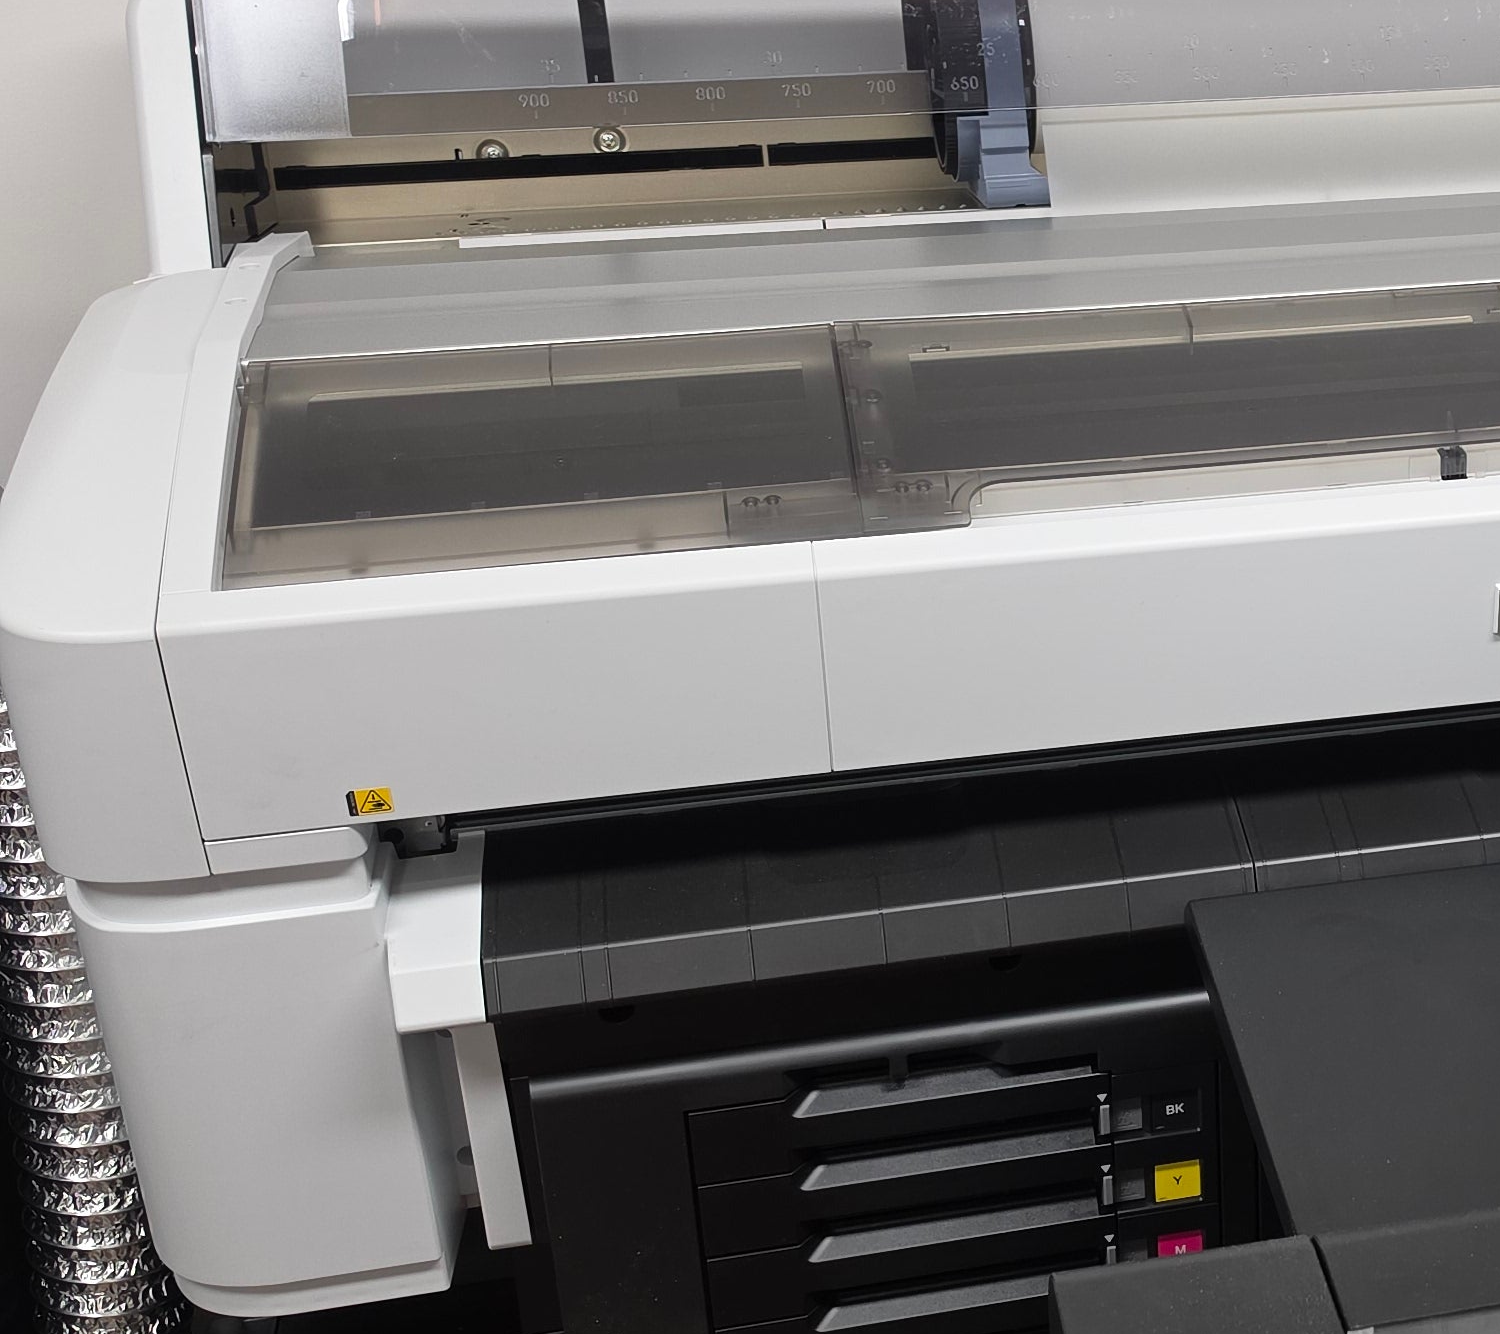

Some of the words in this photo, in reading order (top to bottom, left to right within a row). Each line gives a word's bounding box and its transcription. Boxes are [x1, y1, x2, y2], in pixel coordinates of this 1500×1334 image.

[977, 43, 995, 56] 25
[518, 93, 549, 107] 900
[608, 90, 639, 104] 850
[695, 87, 726, 100] 800
[782, 83, 811, 97] 750
[866, 79, 896, 94] 700
[951, 76, 979, 90] 650
[1166, 1102, 1185, 1116] BK
[1173, 1175, 1183, 1185] Y
[1175, 1244, 1187, 1255] M
